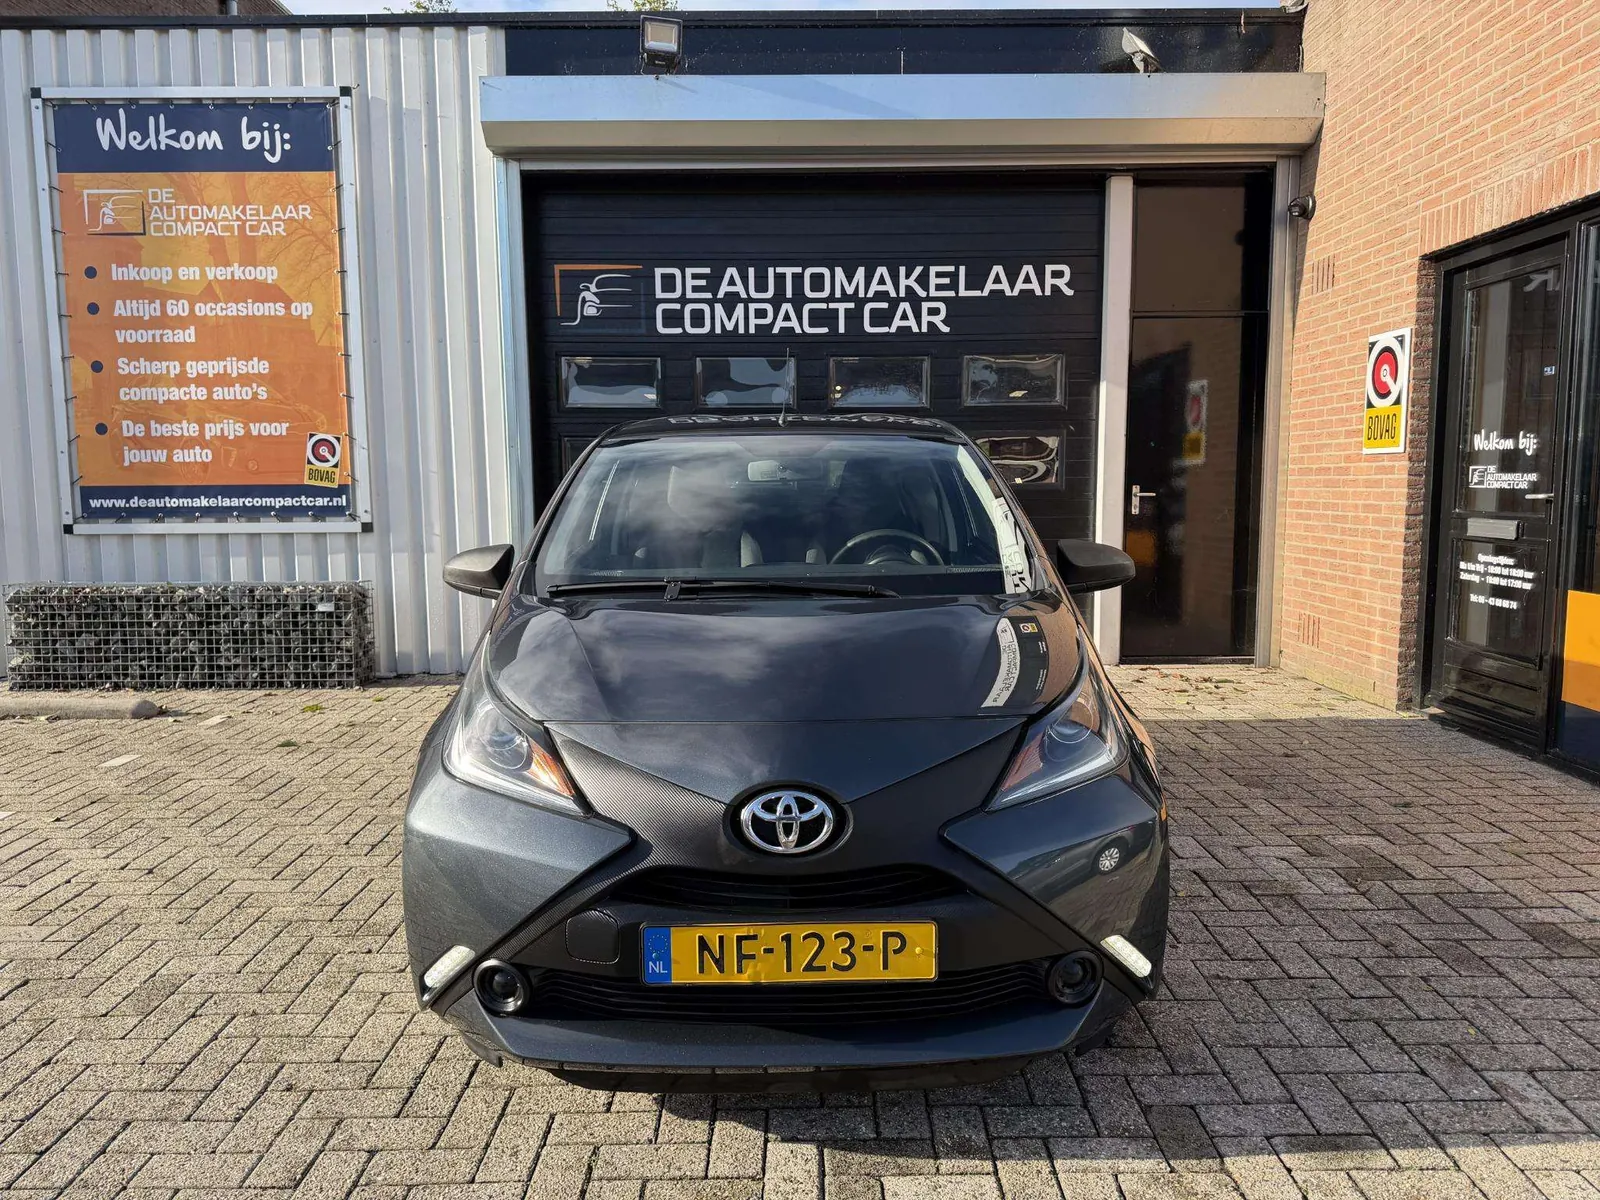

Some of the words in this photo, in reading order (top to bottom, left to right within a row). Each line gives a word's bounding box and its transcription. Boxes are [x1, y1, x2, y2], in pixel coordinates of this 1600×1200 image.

[96, 107, 223, 151] Welkom
[240, 116, 292, 163] bij:
[149, 188, 175, 204] DE
[150, 204, 313, 221] AUTOMAKELAAR
[151, 221, 241, 237] COMPACT
[245, 221, 286, 236] CAR
[111, 263, 173, 283] Inkoop
[178, 266, 200, 281] en
[205, 263, 278, 283] verkoop
[653, 266, 712, 300] DE
[716, 264, 1075, 299] AUTOMAKELAAR
[114, 298, 161, 319] Altijd
[166, 300, 190, 316] 60
[194, 299, 285, 317] occasions
[290, 302, 313, 320] op
[655, 301, 858, 335] COMPACT
[863, 301, 950, 334] CAR
[115, 325, 196, 344] voorraad
[117, 357, 181, 378] Scherp
[186, 357, 270, 378] geprijsde
[119, 384, 208, 404] compacte
[212, 382, 268, 401] auto's
[121, 420, 145, 437] De
[150, 419, 199, 437] beste
[204, 420, 244, 440] prijs
[249, 421, 289, 437] voor
[1367, 413, 1397, 441] BOVAG
[1474, 429, 1514, 451] Welkom
[123, 446, 168, 466] jouw
[172, 447, 213, 463] auto
[307, 468, 336, 485] BOVAG
[1487, 465, 1497, 473] DE
[1487, 473, 1537, 481] AUTOMAKELAAR
[1487, 481, 1514, 489] COMPACT
[1514, 481, 1528, 489] CAR
[89, 495, 347, 509] www.deautomakelaarcompactcar.nl
[696, 930, 908, 975] NF-123-P
[648, 960, 668, 974] NL
